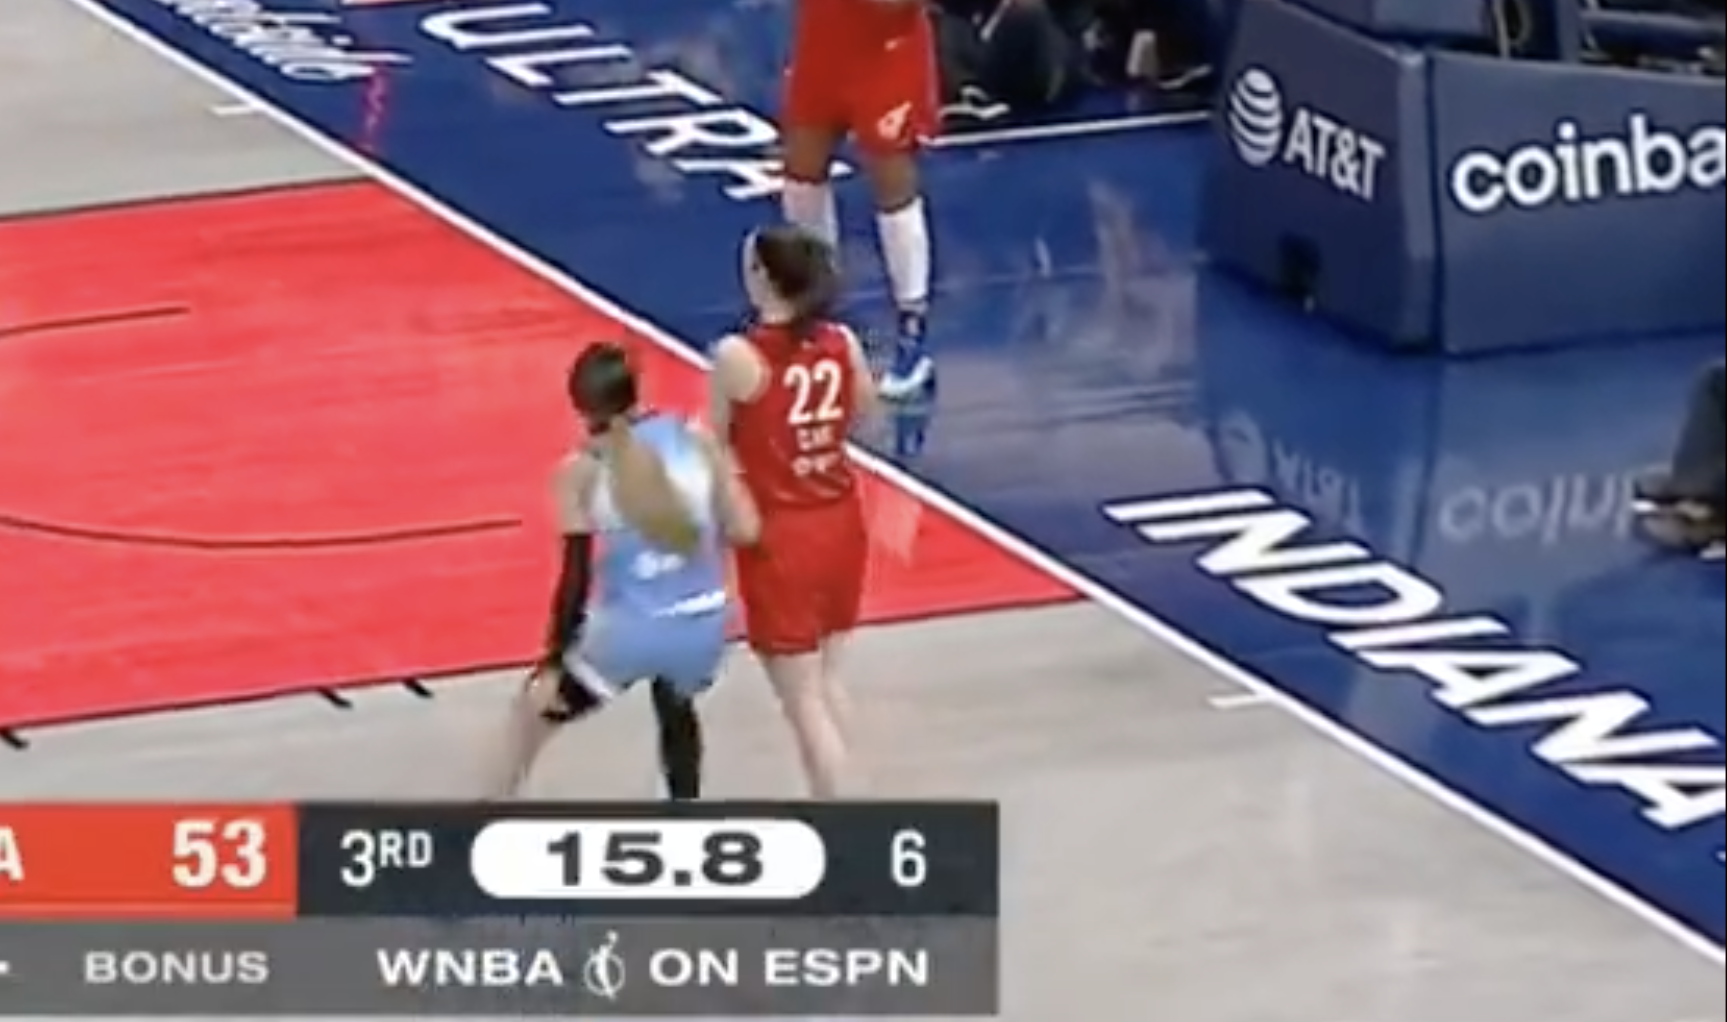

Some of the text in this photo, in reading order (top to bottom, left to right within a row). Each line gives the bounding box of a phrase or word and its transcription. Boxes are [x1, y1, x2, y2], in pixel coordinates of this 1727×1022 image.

[1283, 109, 1386, 202] AT&T
[1452, 114, 1726, 212] coinba
[783, 359, 843, 425] 22
[1103, 489, 1726, 830] INDIANA
